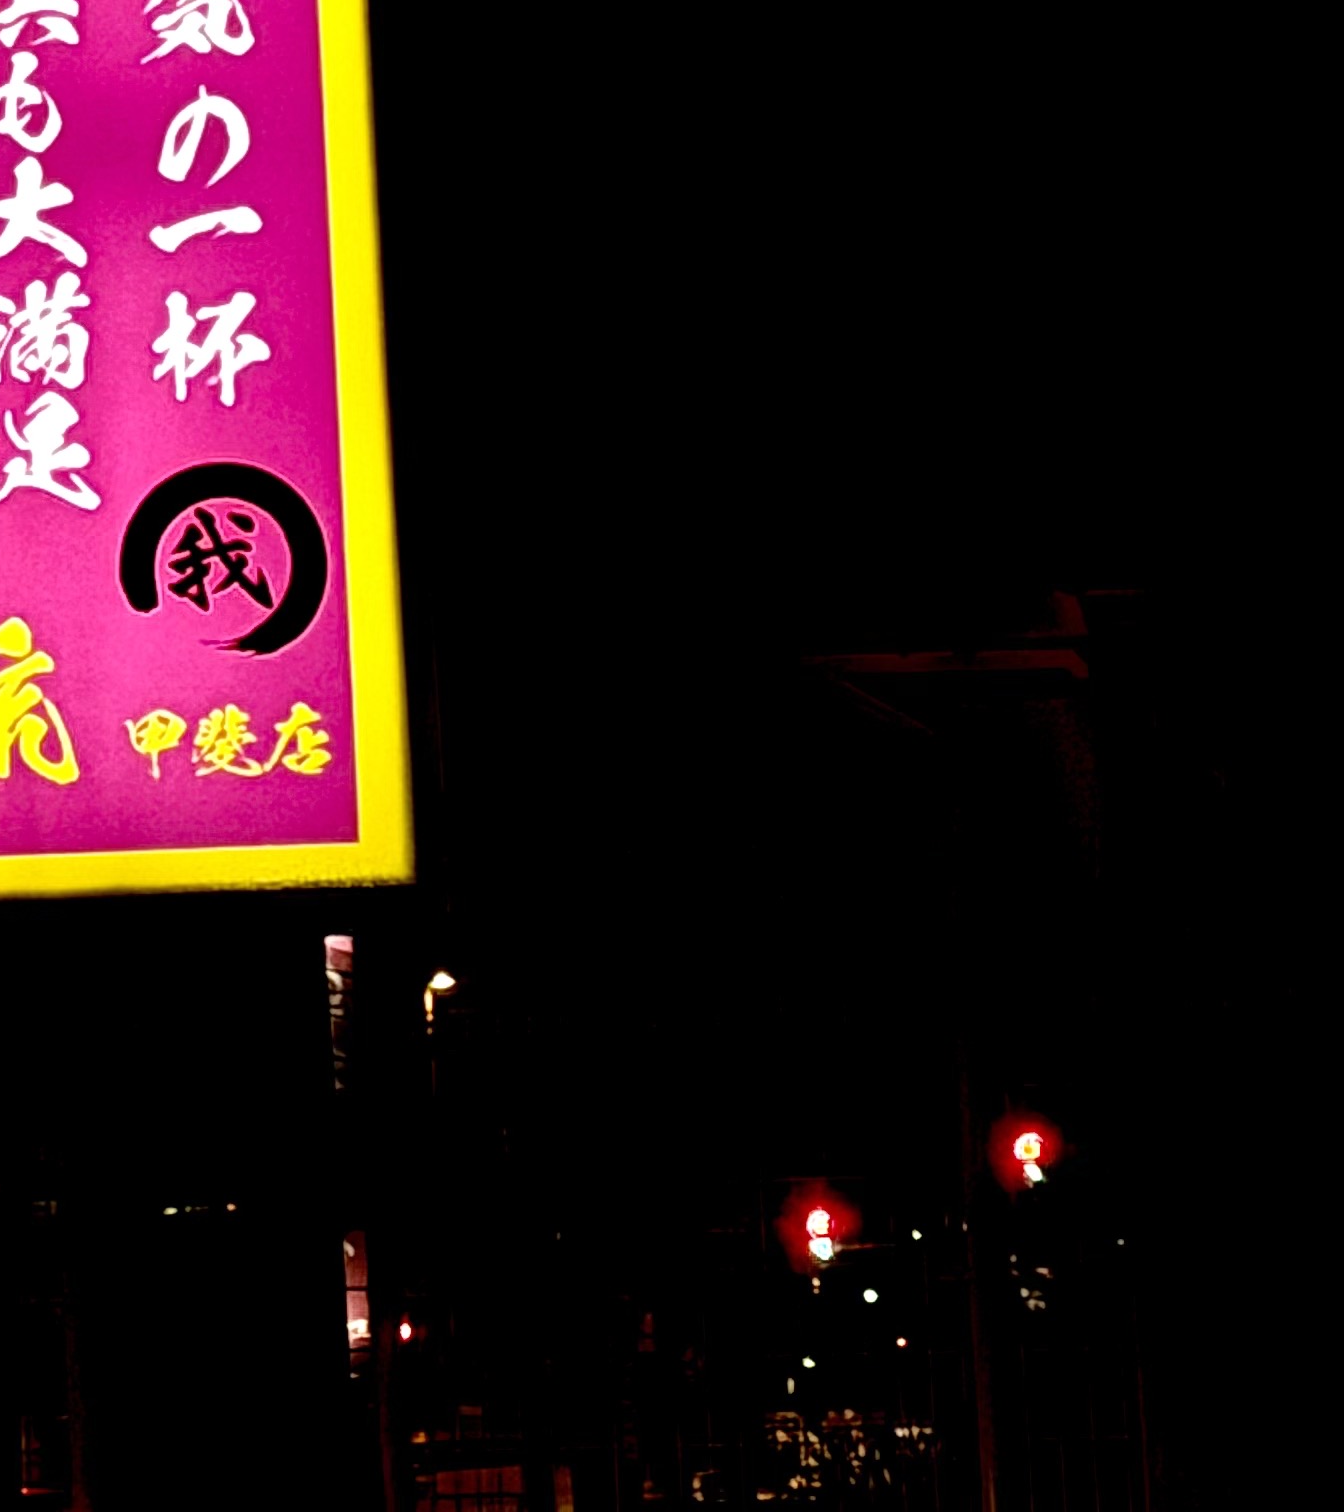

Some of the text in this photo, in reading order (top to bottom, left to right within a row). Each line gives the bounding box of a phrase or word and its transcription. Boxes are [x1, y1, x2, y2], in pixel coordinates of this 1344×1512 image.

[170, 505, 272, 610] 我
[122, 700, 333, 781] 甲斐店
